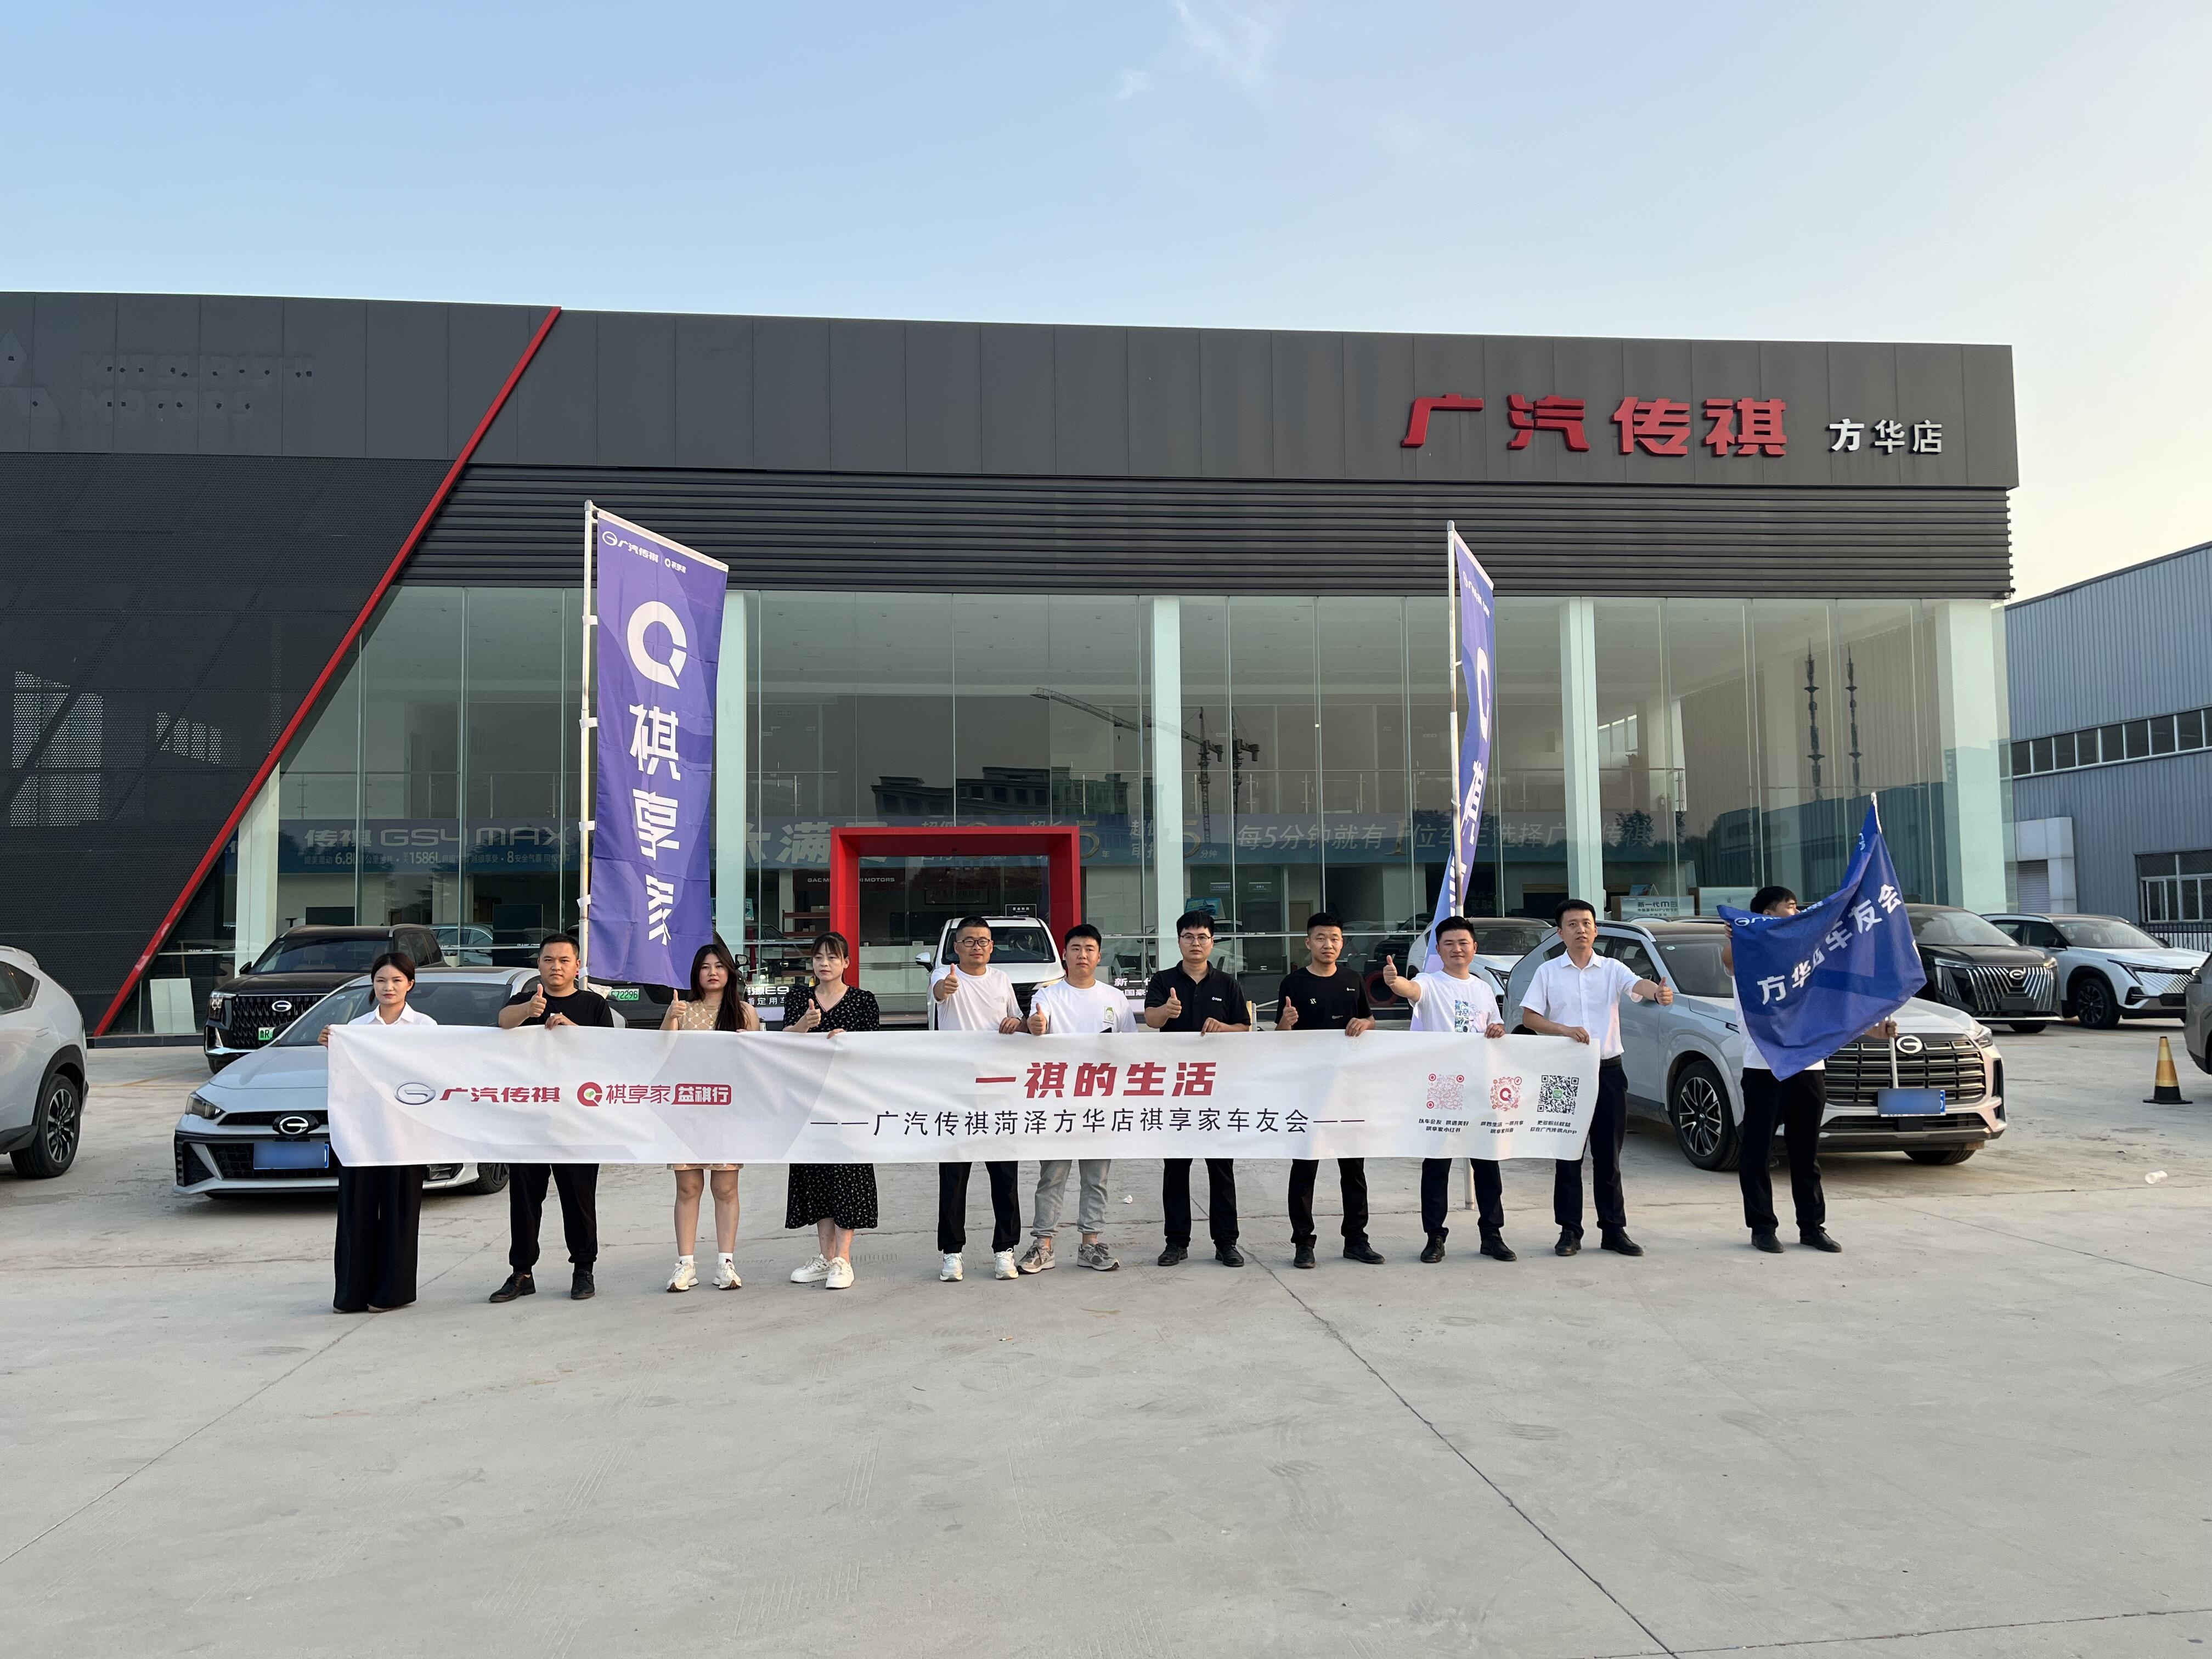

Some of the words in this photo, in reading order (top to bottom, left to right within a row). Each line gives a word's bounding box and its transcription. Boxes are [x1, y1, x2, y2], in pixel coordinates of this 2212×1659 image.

[1401, 393, 1787, 456] 广汽传祺
[1825, 419, 1943, 455] 方华店
[476, 826, 571, 846] MAX
[1199, 849, 1218, 859] 分钟
[975, 1061, 1217, 1098] 一祺的生活
[439, 1086, 561, 1104] 广汽传祺
[606, 1084, 672, 1105] 祺享家
[677, 1086, 730, 1103] 益祺行
